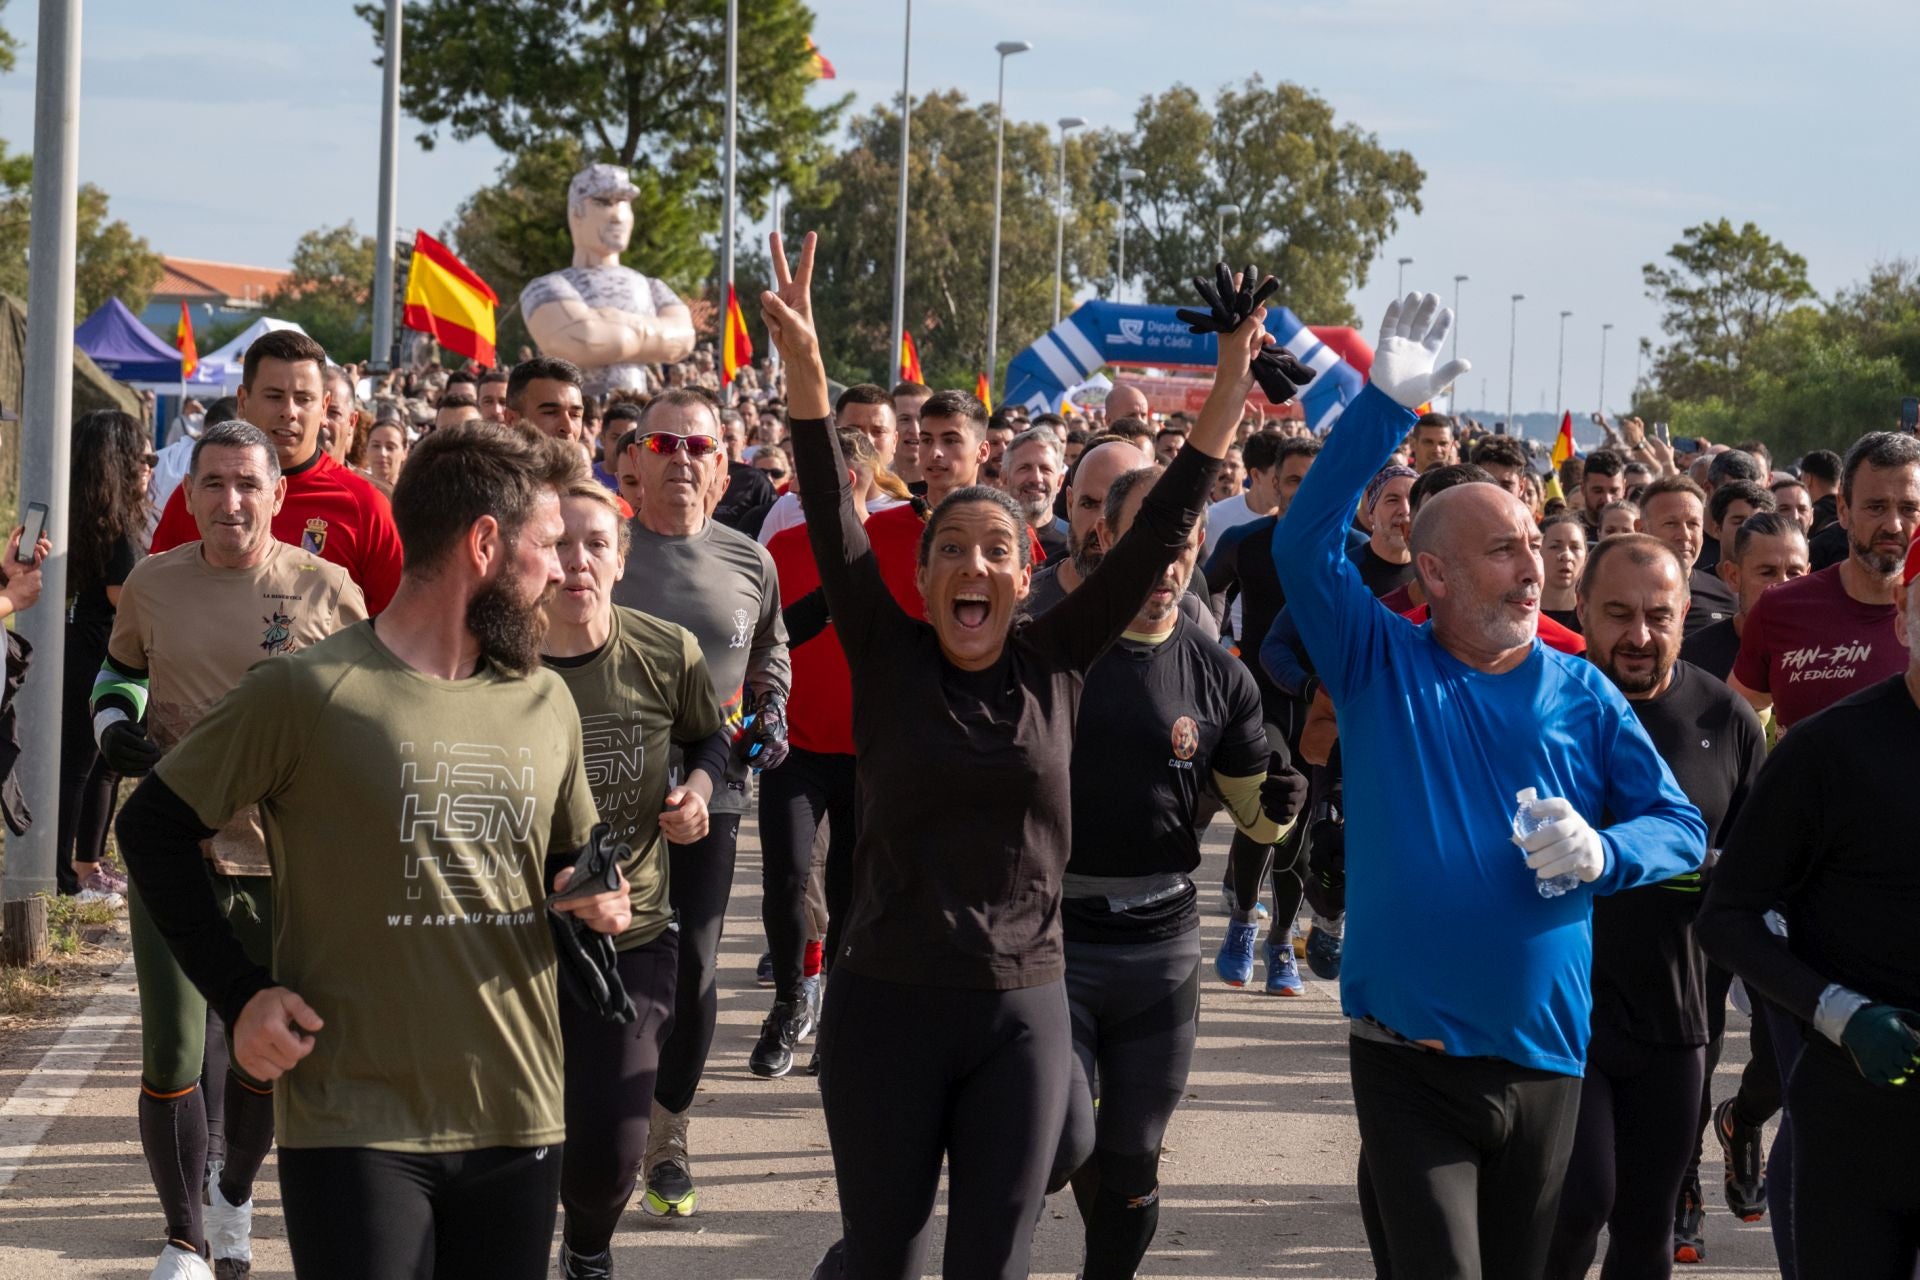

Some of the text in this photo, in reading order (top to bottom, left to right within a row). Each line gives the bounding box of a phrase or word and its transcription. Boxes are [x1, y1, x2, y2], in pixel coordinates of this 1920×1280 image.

[1147, 335, 1160, 346] de
[1789, 671, 1802, 683] IX
[584, 746, 645, 787] SN
[400, 793, 536, 842] HSN
[387, 914, 413, 926] WE
[422, 914, 457, 926] ARE
